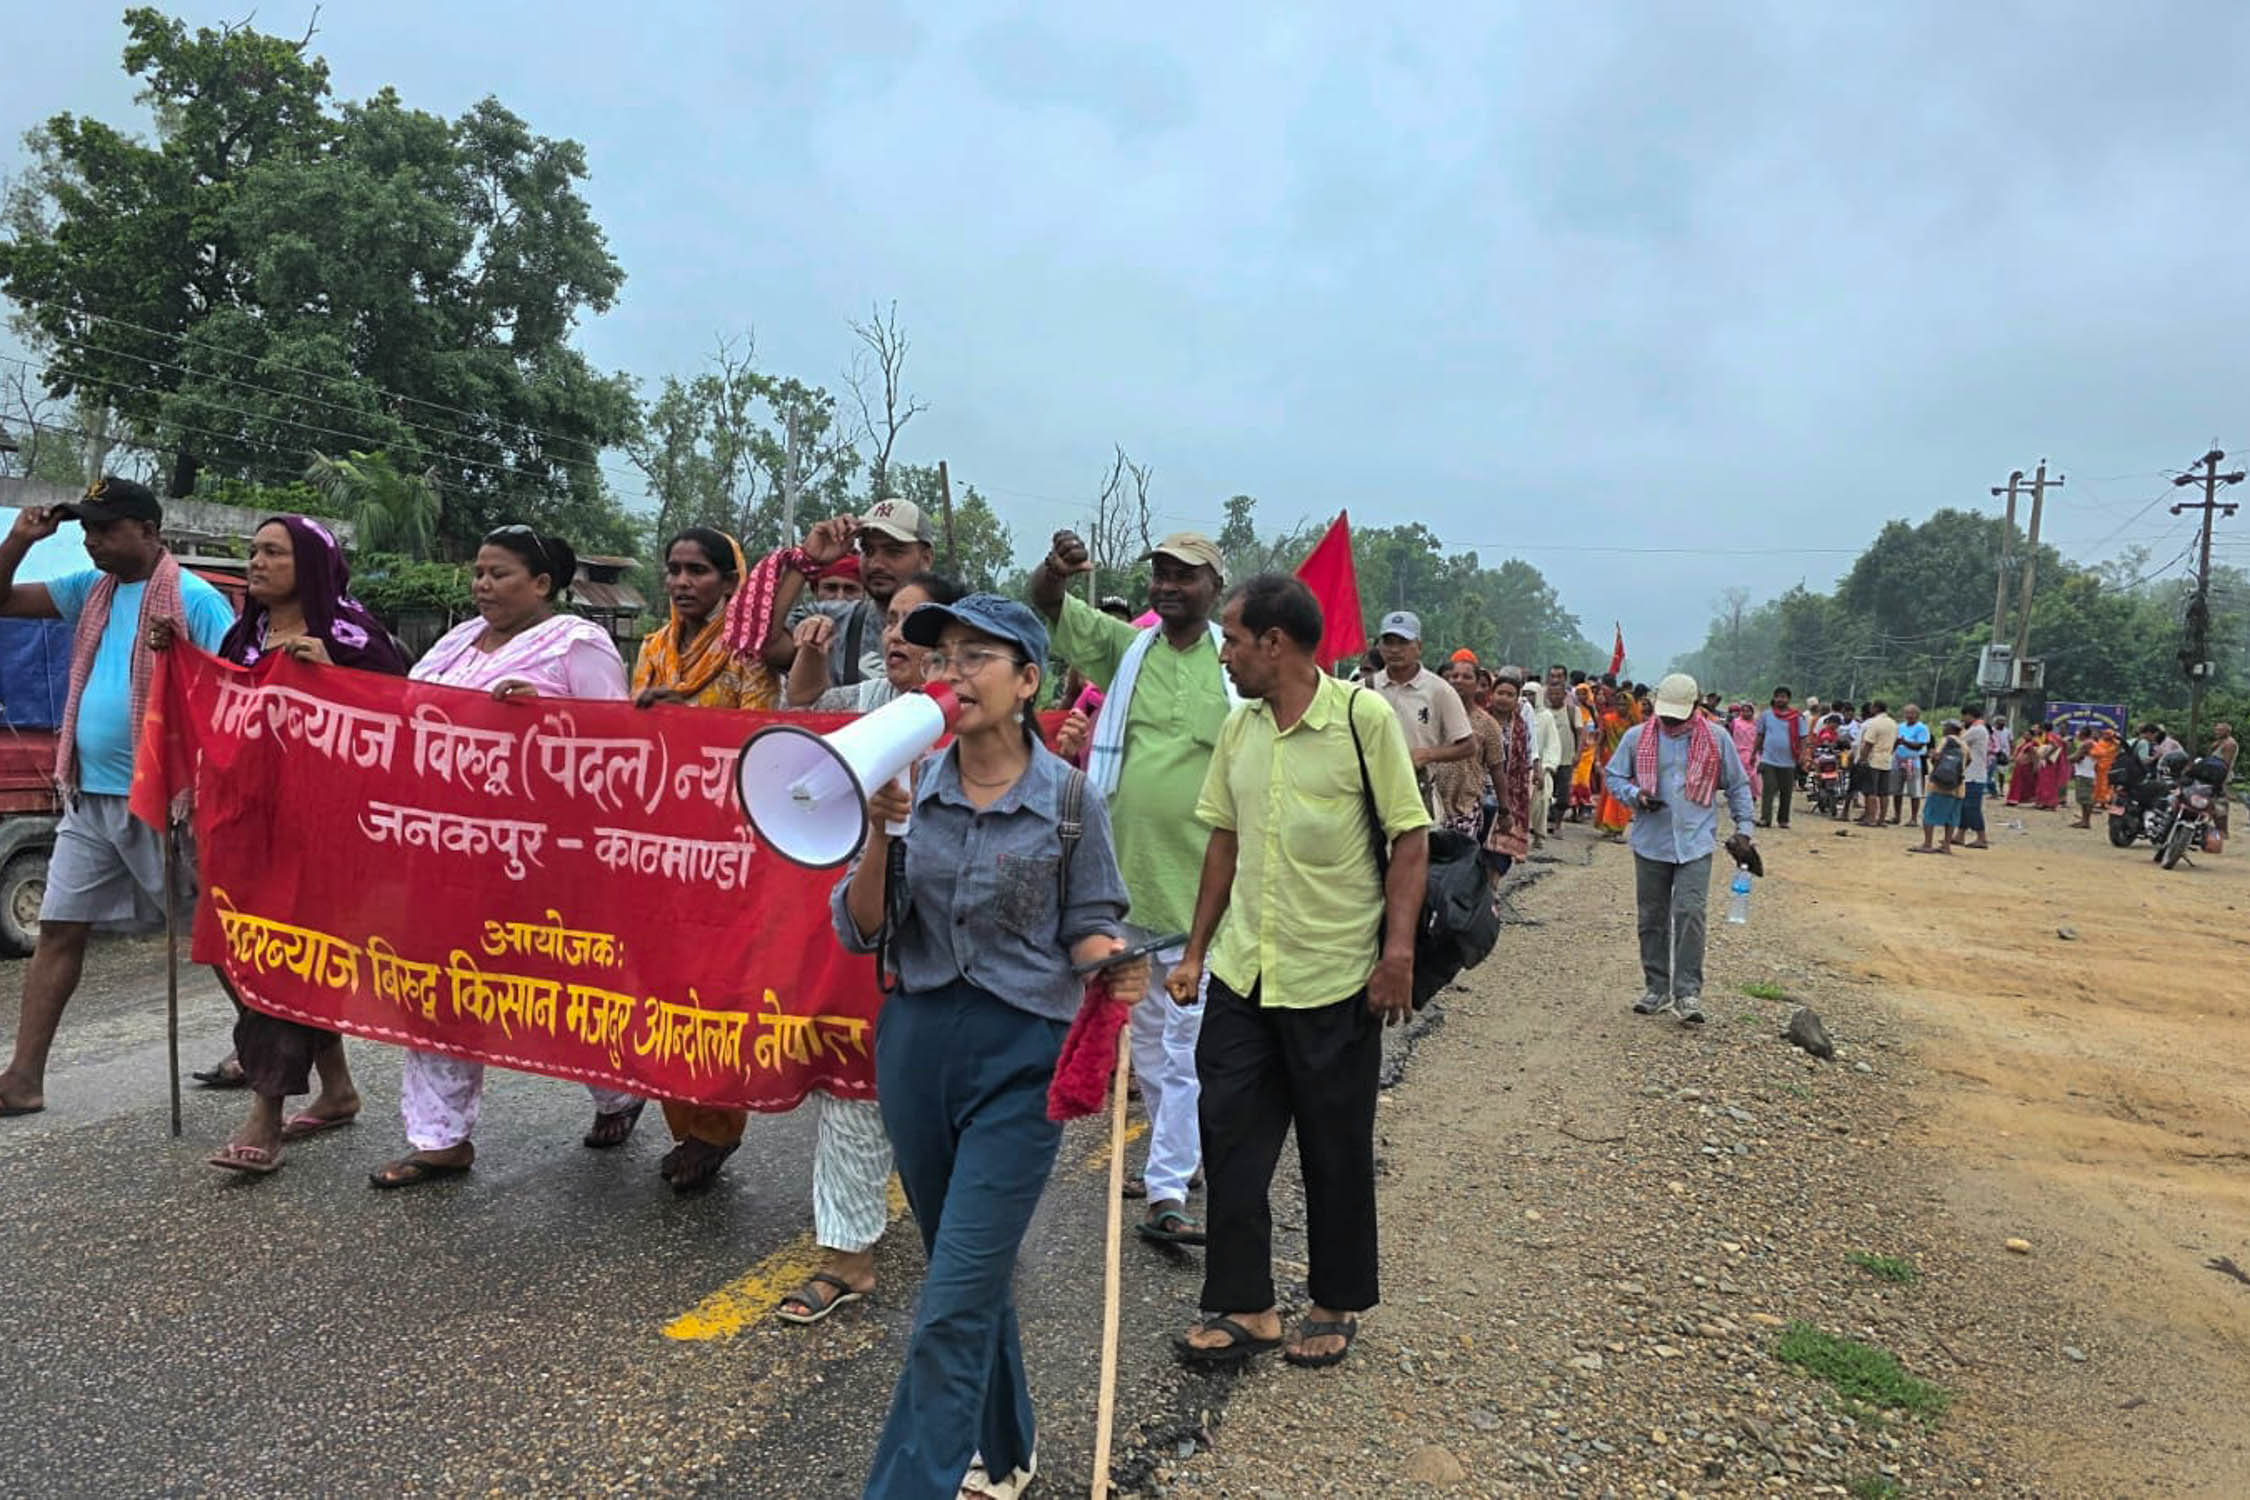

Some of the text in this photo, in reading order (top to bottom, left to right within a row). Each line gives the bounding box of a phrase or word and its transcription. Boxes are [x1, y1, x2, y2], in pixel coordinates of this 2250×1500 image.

[521, 710, 668, 815] (पैदल)
[674, 746, 742, 815] न्या
[357, 800, 548, 881] जनकपुर
[444, 949, 564, 1041] किसान
[633, 987, 751, 1087] आन्दोलन,
[754, 988, 872, 1077] नेपाल
